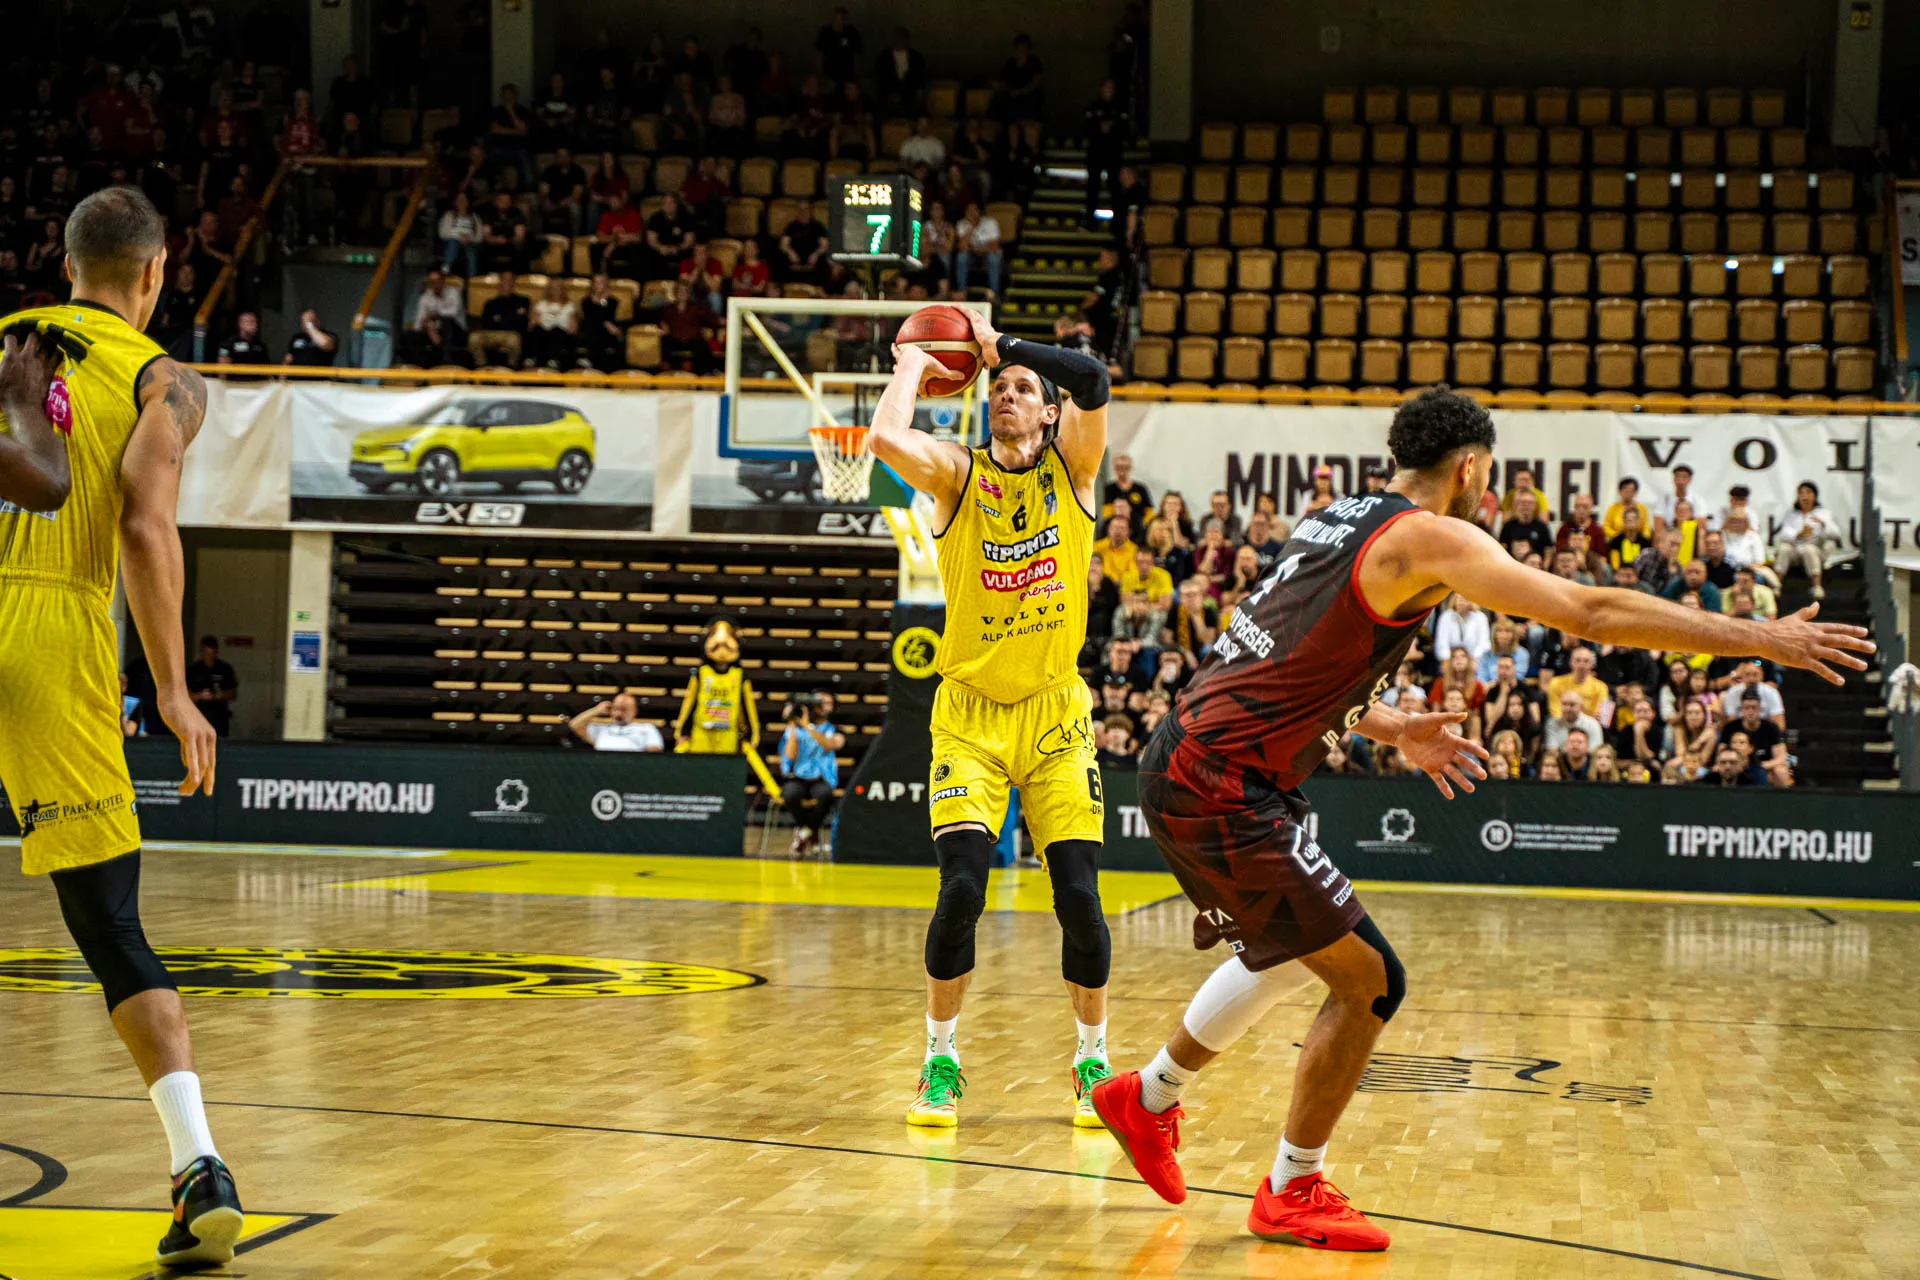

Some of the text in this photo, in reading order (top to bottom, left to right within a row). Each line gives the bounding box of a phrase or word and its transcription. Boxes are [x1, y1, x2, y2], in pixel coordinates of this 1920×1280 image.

[867, 214, 891, 255] 7
[1012, 505, 1027, 533] 6
[984, 560, 1056, 589] VULCANO
[1018, 580, 1066, 602] energia
[981, 603, 1066, 626] VOLVO
[1016, 621, 1044, 637] AUTÓ
[1046, 619, 1067, 632] KFT.
[237, 778, 434, 814] TIPPMIXPRO.HU
[1086, 768, 1103, 803] 6
[1663, 824, 1873, 863] TIPPMIXPRO.HU
